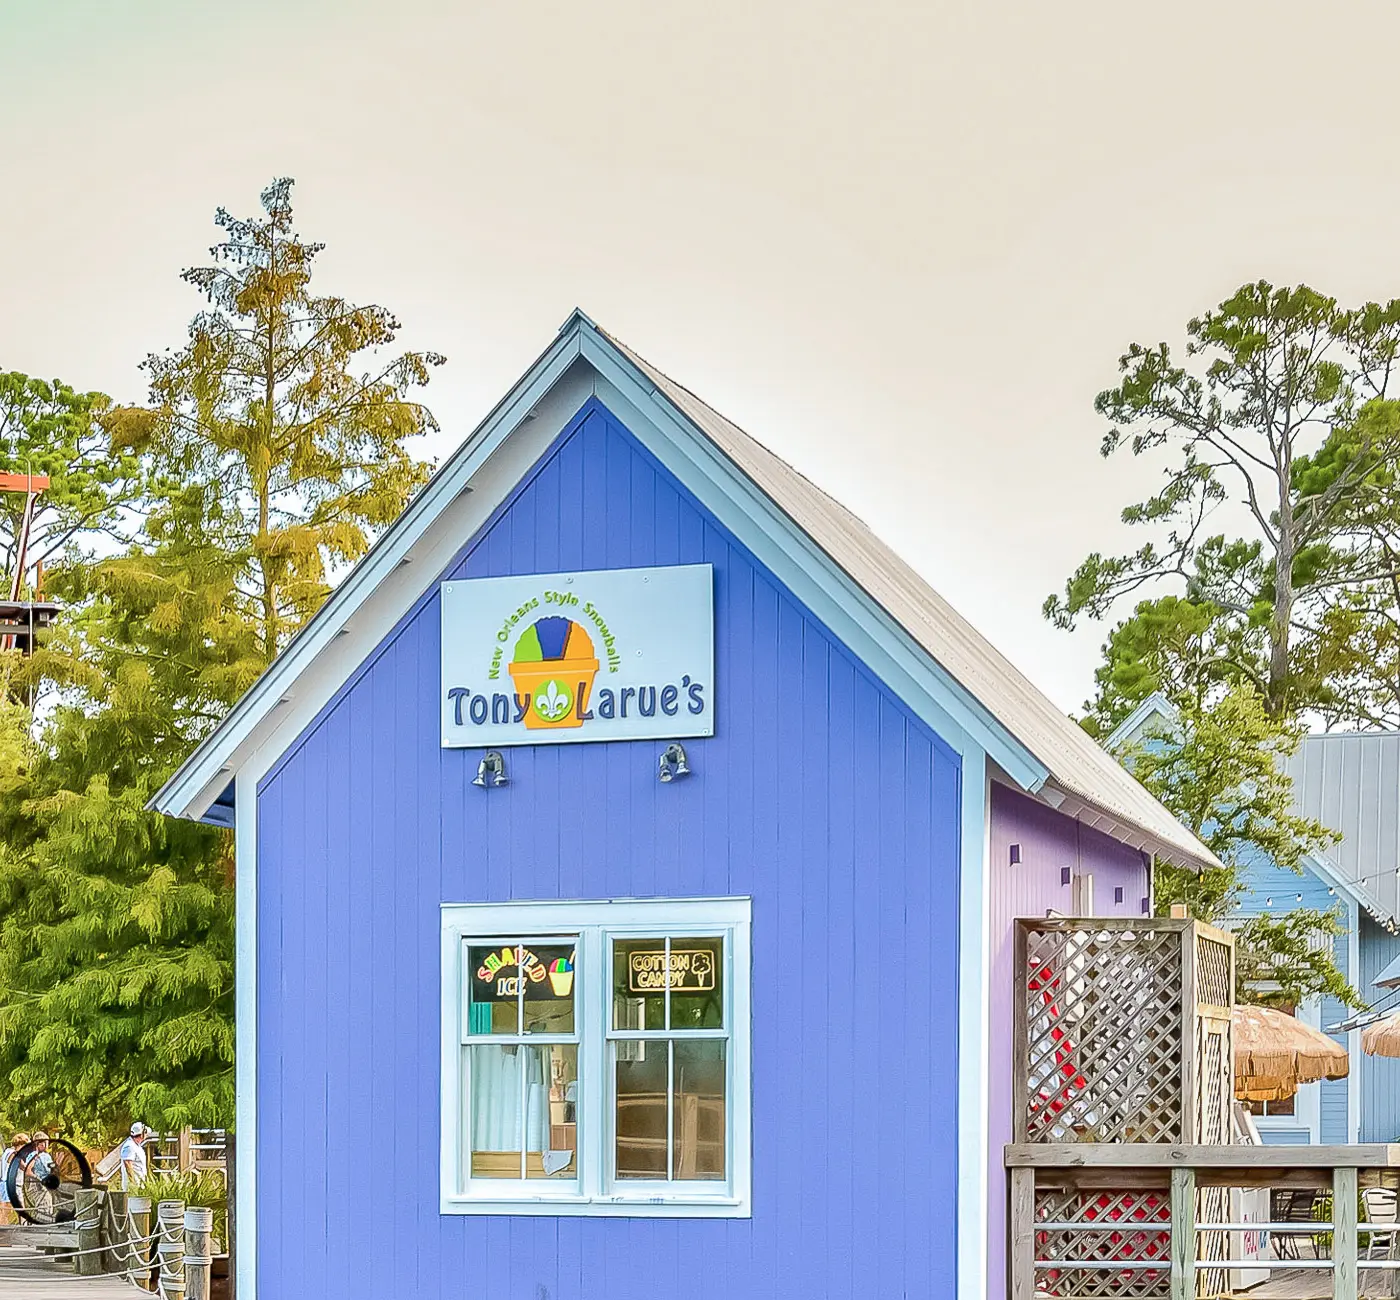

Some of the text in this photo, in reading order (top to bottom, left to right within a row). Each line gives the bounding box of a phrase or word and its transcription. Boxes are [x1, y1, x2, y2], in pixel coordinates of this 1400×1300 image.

[489, 591, 620, 679] New Orleans Style Snowballs
[448, 675, 705, 726] Tony Larue's
[632, 954, 690, 972] COTTON
[496, 976, 528, 996] ICE
[637, 970, 686, 988] CANDY
